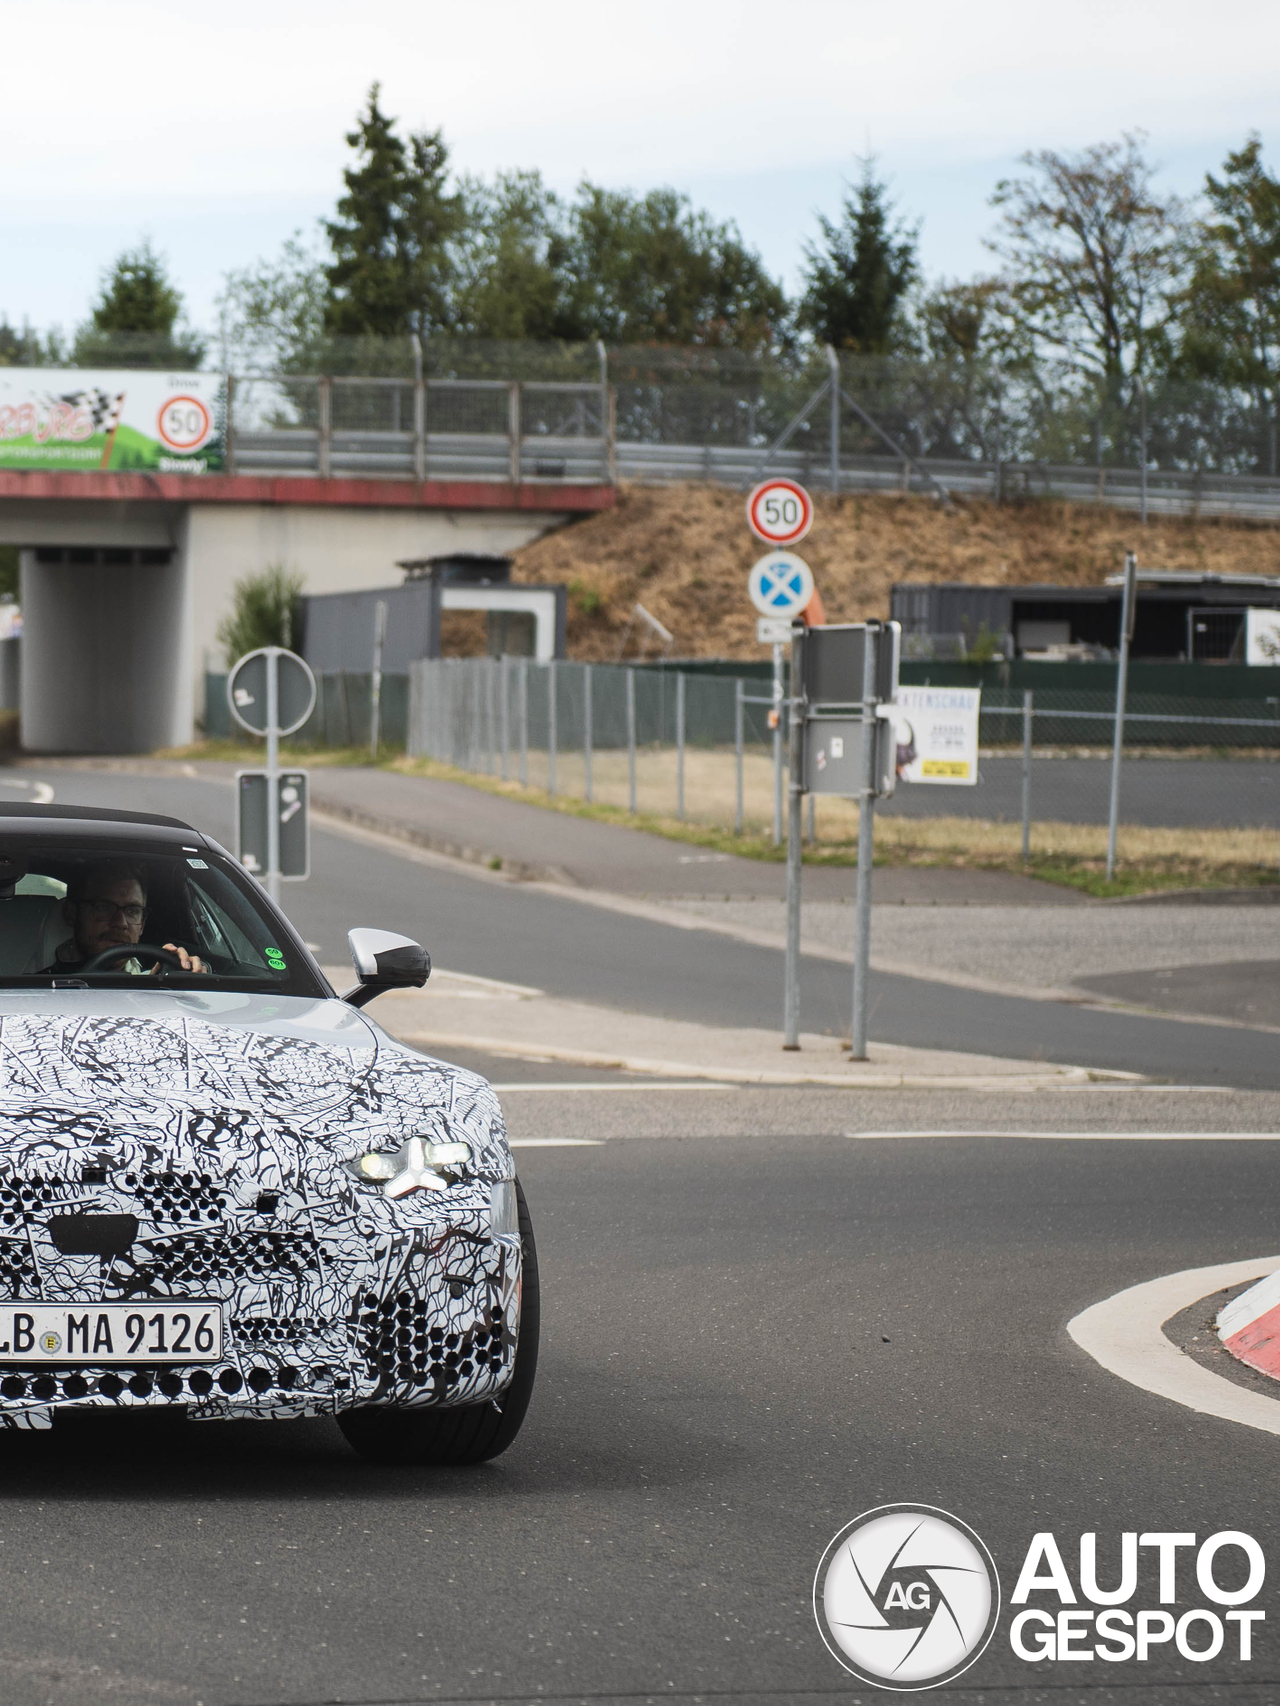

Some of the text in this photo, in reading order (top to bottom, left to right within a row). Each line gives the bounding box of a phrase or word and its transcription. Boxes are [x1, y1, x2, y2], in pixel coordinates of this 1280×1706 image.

[169, 410, 200, 434] 50
[765, 498, 798, 525] 50
[67, 1313, 114, 1353] MA
[125, 1313, 214, 1353] 9126
